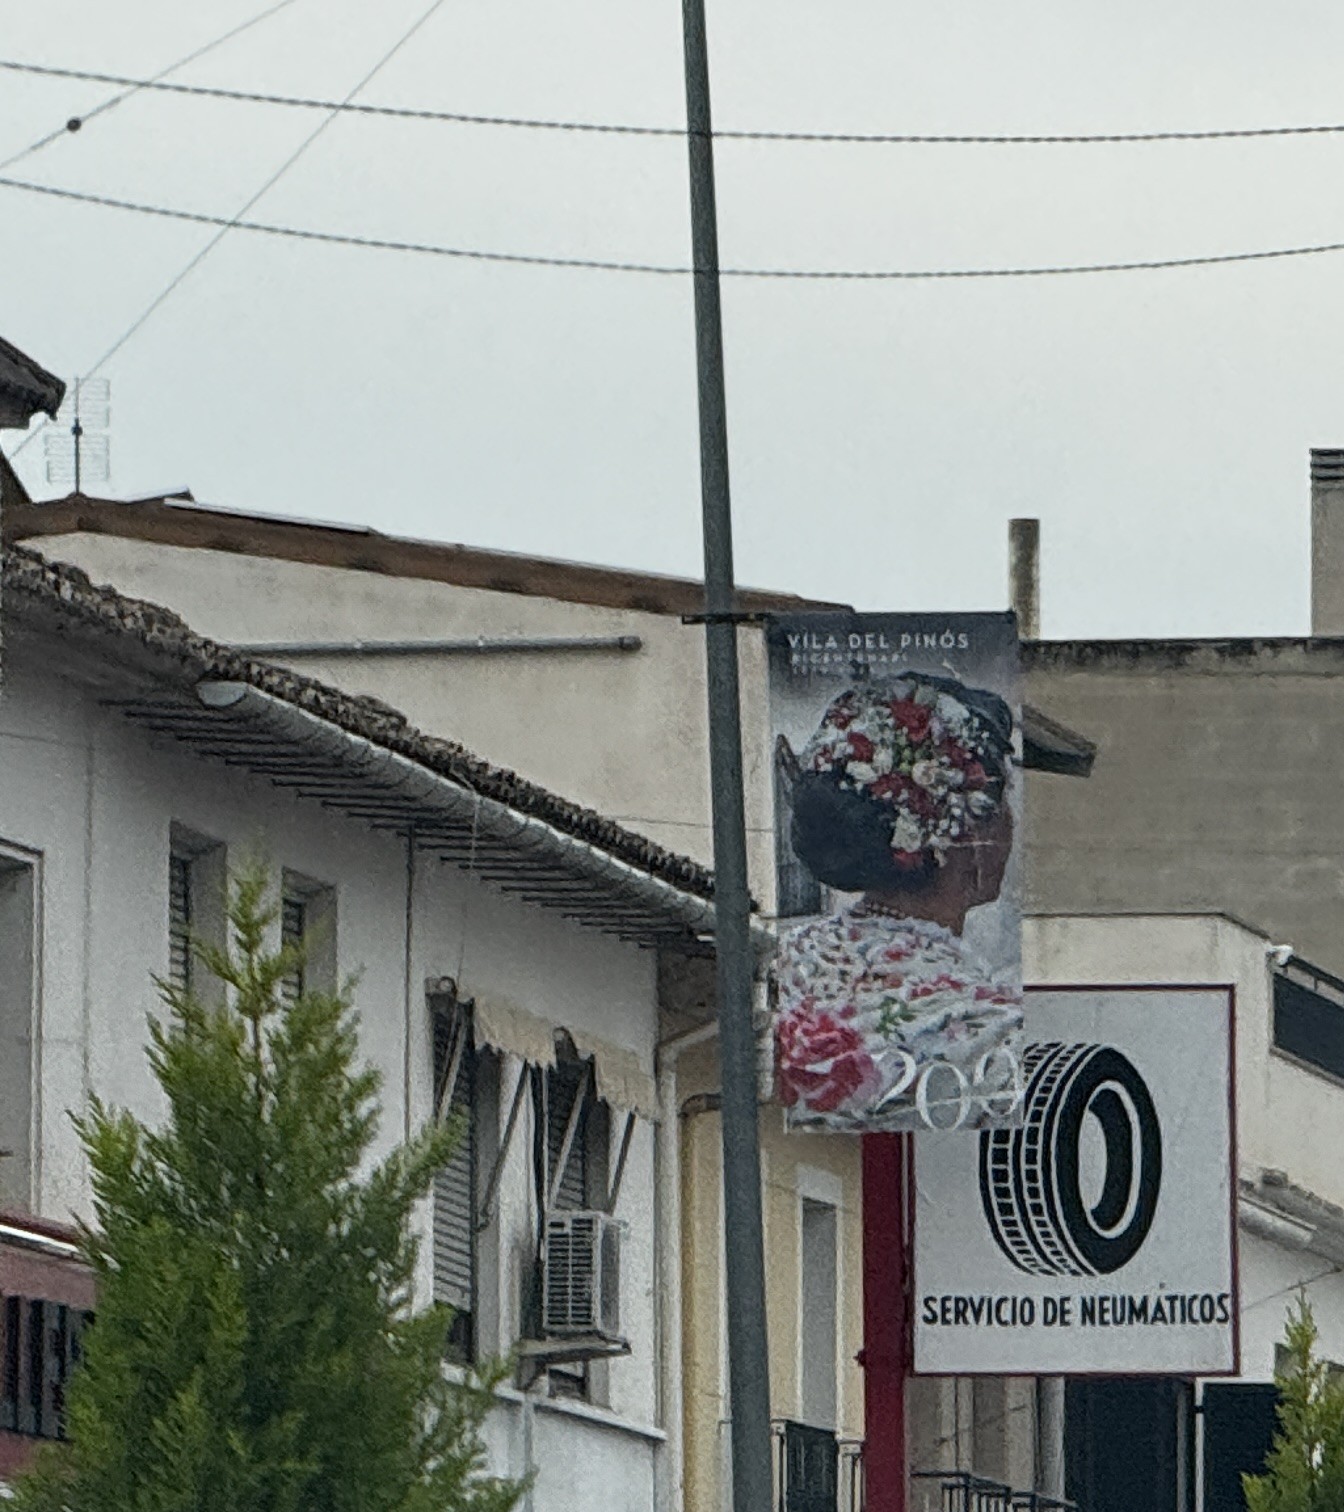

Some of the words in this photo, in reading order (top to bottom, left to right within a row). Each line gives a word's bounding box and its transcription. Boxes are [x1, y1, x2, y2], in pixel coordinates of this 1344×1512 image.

[787, 632, 838, 649] VILA
[849, 633, 890, 649] DEL
[901, 629, 969, 649] PINÓS
[922, 1296, 1035, 1327] SERVICIO
[1043, 1297, 1071, 1327] DE
